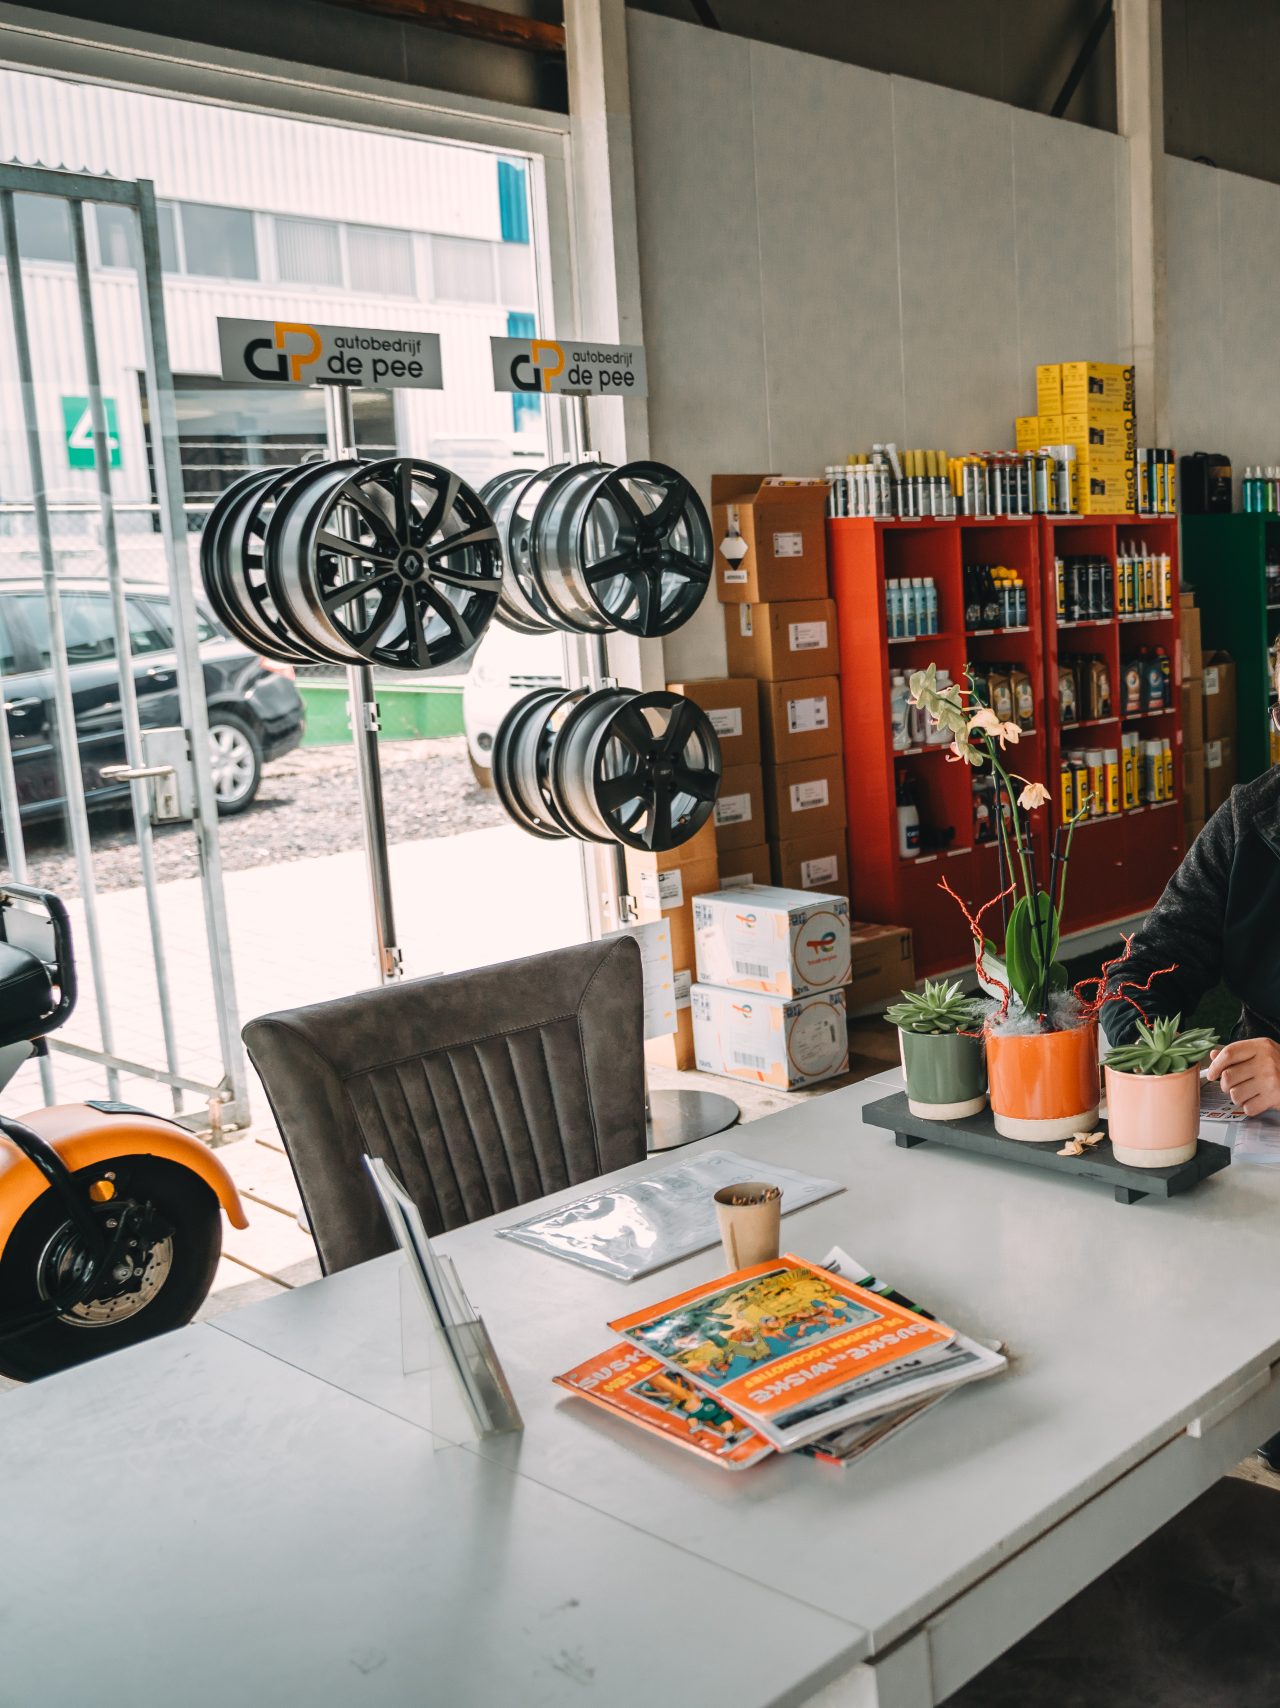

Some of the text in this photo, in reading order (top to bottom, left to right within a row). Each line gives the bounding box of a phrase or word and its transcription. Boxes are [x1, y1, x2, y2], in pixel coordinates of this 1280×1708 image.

[334, 336, 422, 358] autobedrijf
[572, 350, 634, 369] autobedrijf
[327, 351, 424, 383] de pee
[568, 359, 635, 392] de pee
[847, 1323, 930, 1361] SUSKE
[578, 1350, 650, 1390] SUSK
[749, 1361, 837, 1404] WISKE
